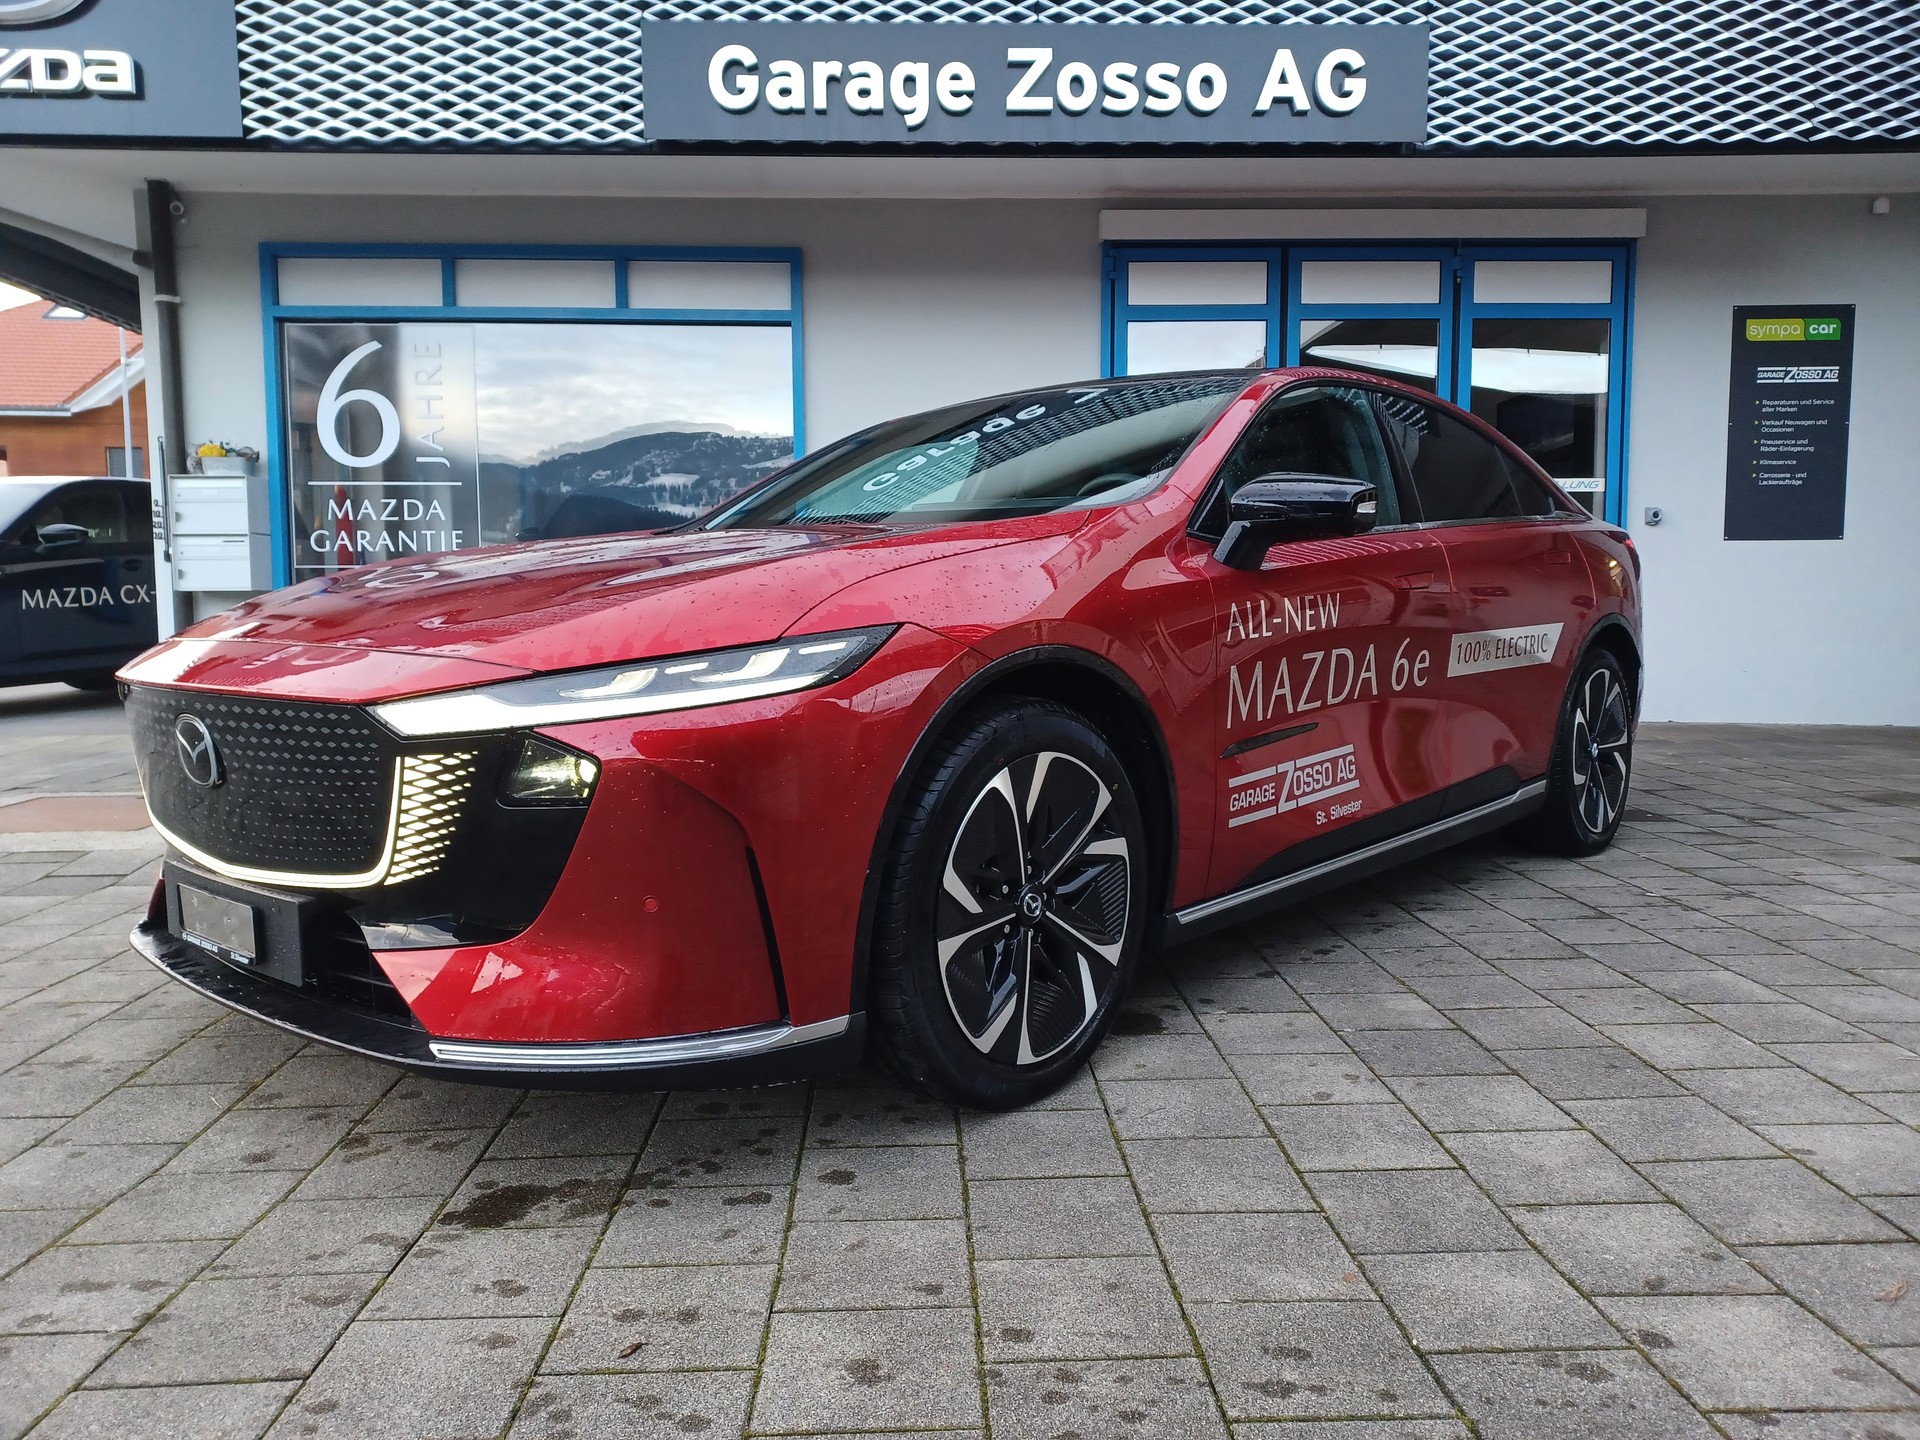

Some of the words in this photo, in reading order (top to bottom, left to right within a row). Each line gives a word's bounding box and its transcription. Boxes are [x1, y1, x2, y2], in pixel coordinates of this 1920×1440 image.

[707, 43, 976, 131] Garage
[1006, 47, 1228, 116] Zosso
[1252, 48, 1367, 117] AG
[1749, 324, 1801, 338] sympa
[1808, 323, 1838, 334] car
[1784, 366, 1822, 384] ZOSSO
[1823, 370, 1839, 379] AG
[316, 340, 400, 468] 6
[413, 343, 451, 468] JAHRE
[1760, 445, 1815, 453] Räder-Einlagerung
[327, 498, 446, 521] MAZDA
[309, 530, 464, 552] GARANTIE
[22, 585, 114, 610] MAZDA
[1226, 592, 1340, 641] ALL-NEW
[1457, 639, 1492, 665] 100%
[1495, 633, 1549, 660] ELECTRIC
[1226, 643, 1378, 729] MAZDA
[1391, 637, 1431, 692] 6e
[1229, 782, 1276, 812] GARAGE
[1277, 759, 1333, 814] ZOSSO
[1336, 754, 1356, 783] AG
[1316, 810, 1328, 825] St.
[1330, 799, 1363, 820] Silvester
